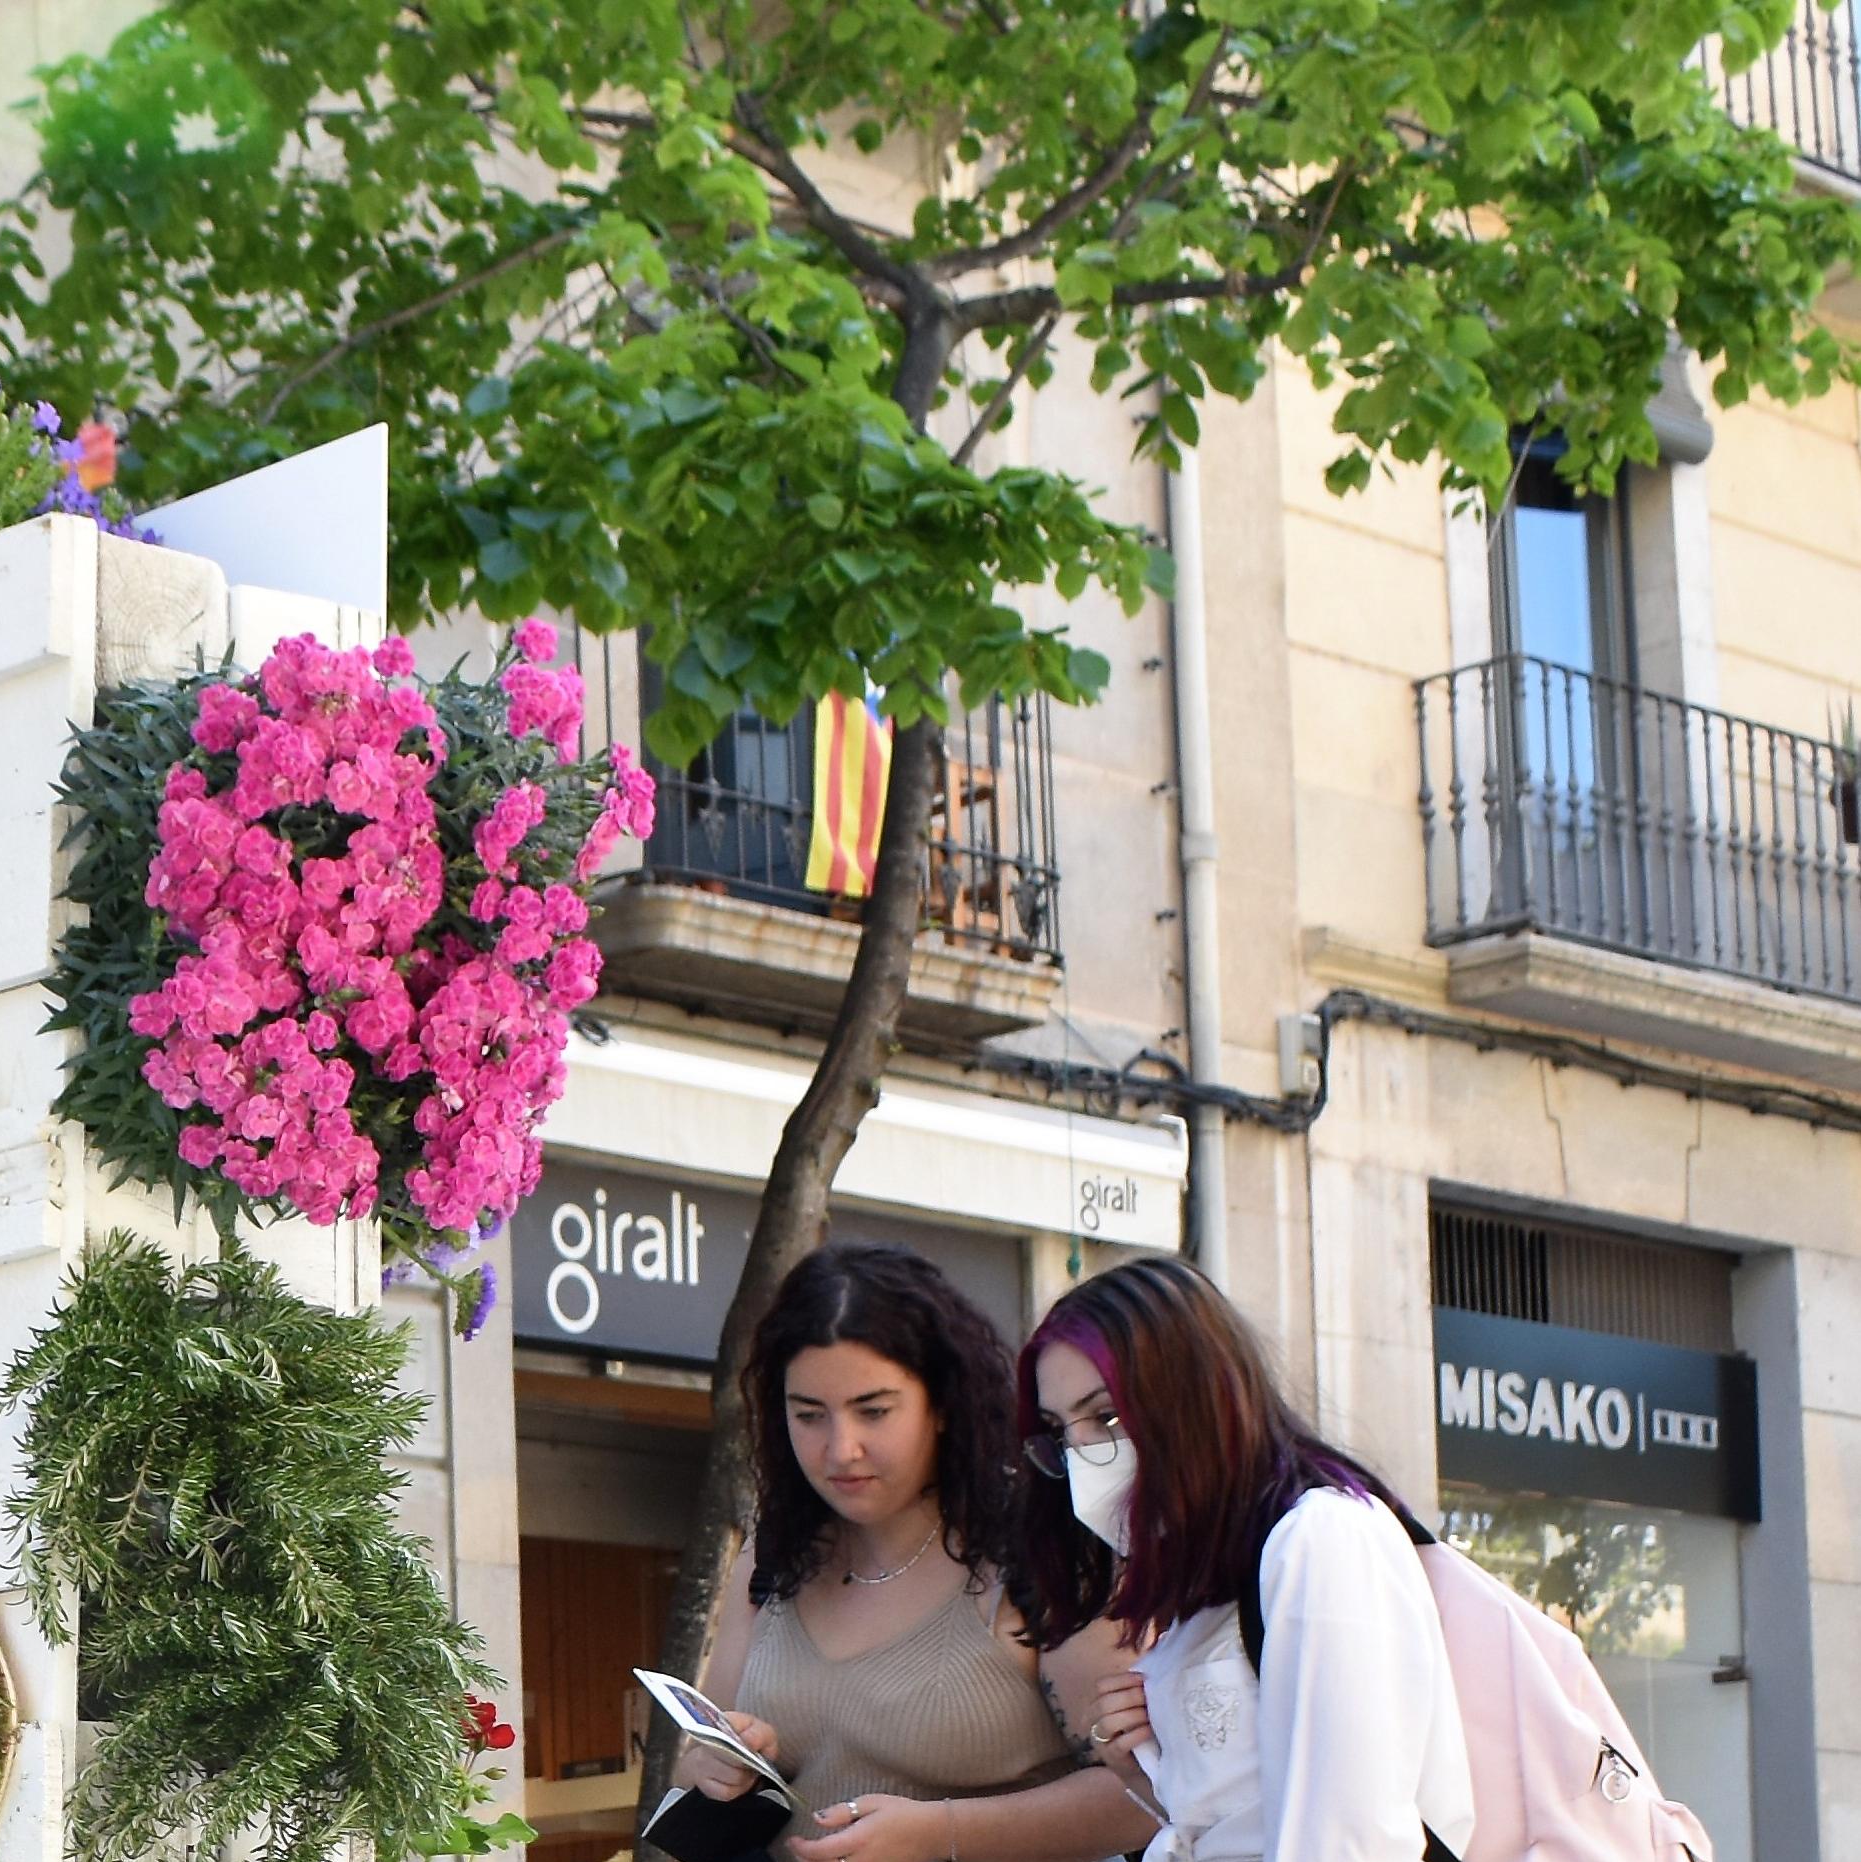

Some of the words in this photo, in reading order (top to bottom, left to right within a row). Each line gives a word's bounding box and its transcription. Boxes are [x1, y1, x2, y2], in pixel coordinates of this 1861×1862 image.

[1080, 1174, 1137, 1231] giralt
[547, 1188, 705, 1334] giralt
[1440, 1362, 1632, 1449] MISAKO
